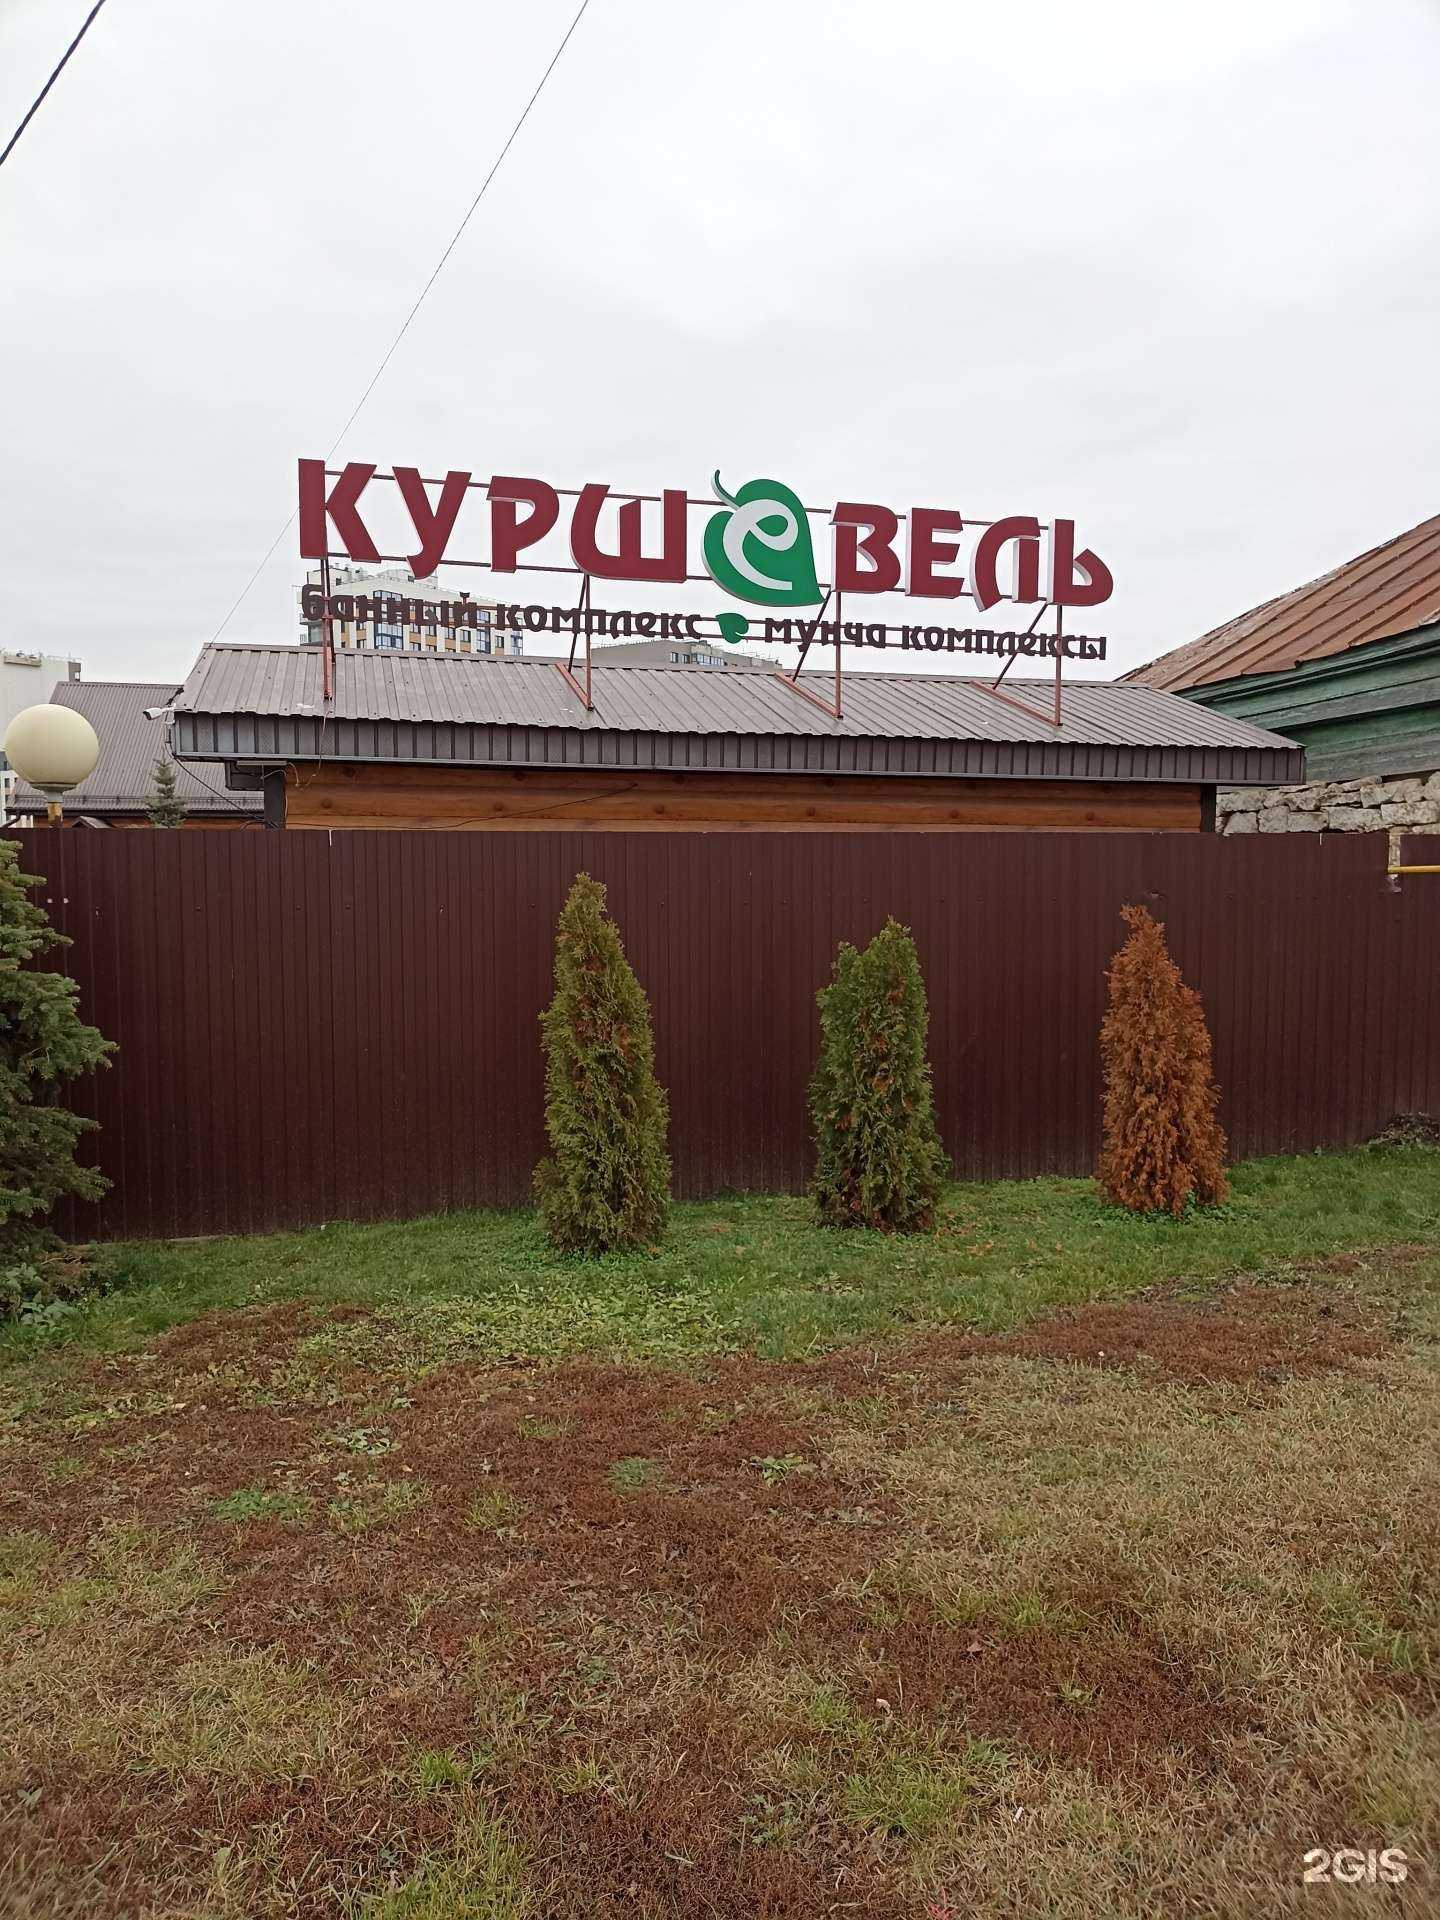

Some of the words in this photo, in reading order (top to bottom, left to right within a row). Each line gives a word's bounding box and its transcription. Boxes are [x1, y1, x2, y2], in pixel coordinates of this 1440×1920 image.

[301, 583, 477, 629] банный
[497, 602, 701, 640] комплекс
[764, 616, 887, 652] мунча
[902, 625, 1107, 660] комплексы
